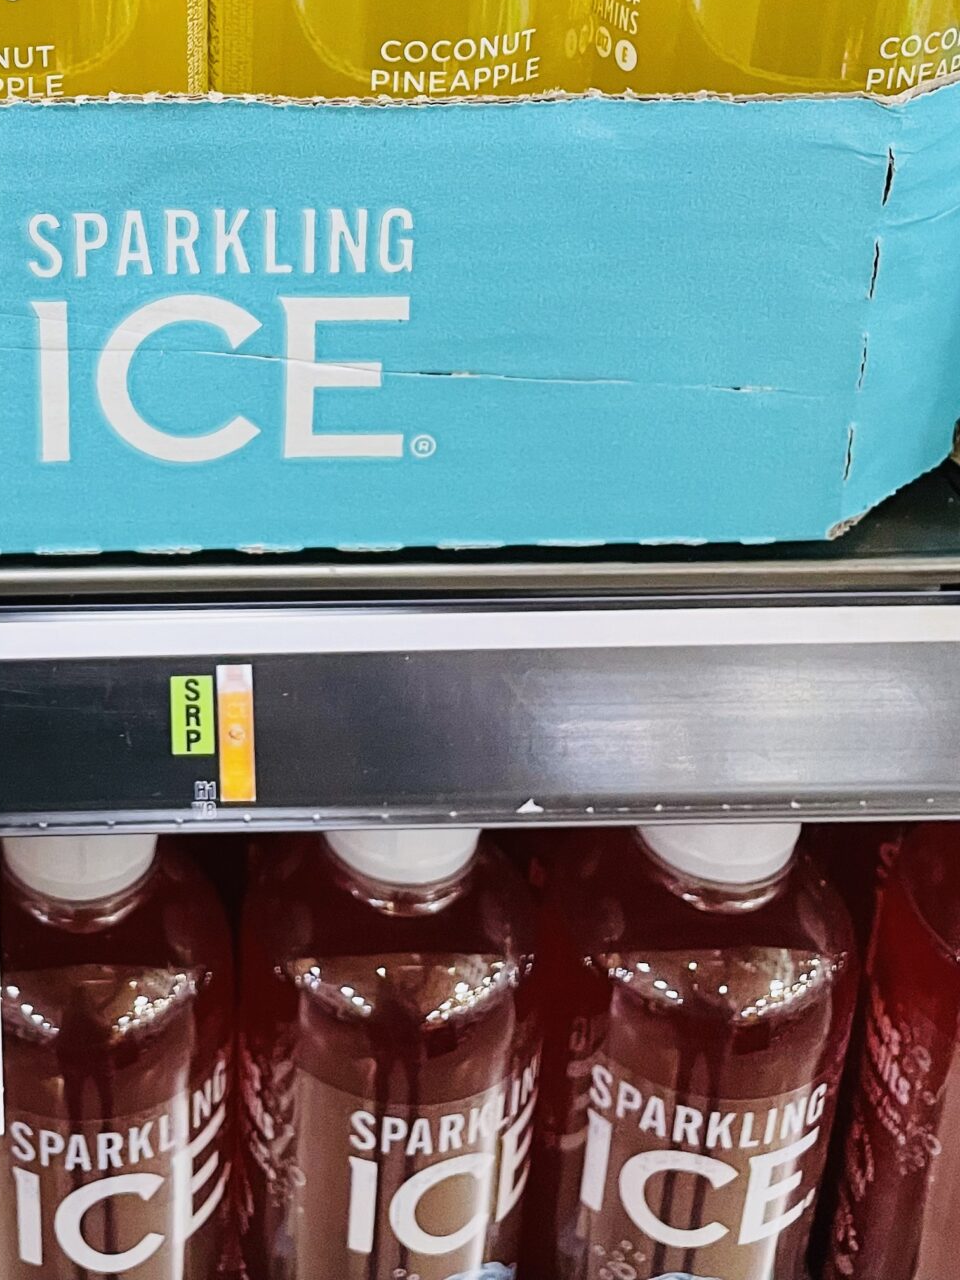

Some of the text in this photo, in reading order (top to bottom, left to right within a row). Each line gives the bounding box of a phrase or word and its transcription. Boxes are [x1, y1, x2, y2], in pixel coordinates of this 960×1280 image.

[370, 57, 540, 93] PINEAPPLE
[380, 28, 537, 63] COCONUT
[880, 28, 960, 60] COCO
[28, 208, 414, 278] SPARKLING
[30, 294, 410, 462] ICE
[589, 1064, 827, 1150] SPARKLING
[580, 1106, 818, 1247] ICE
